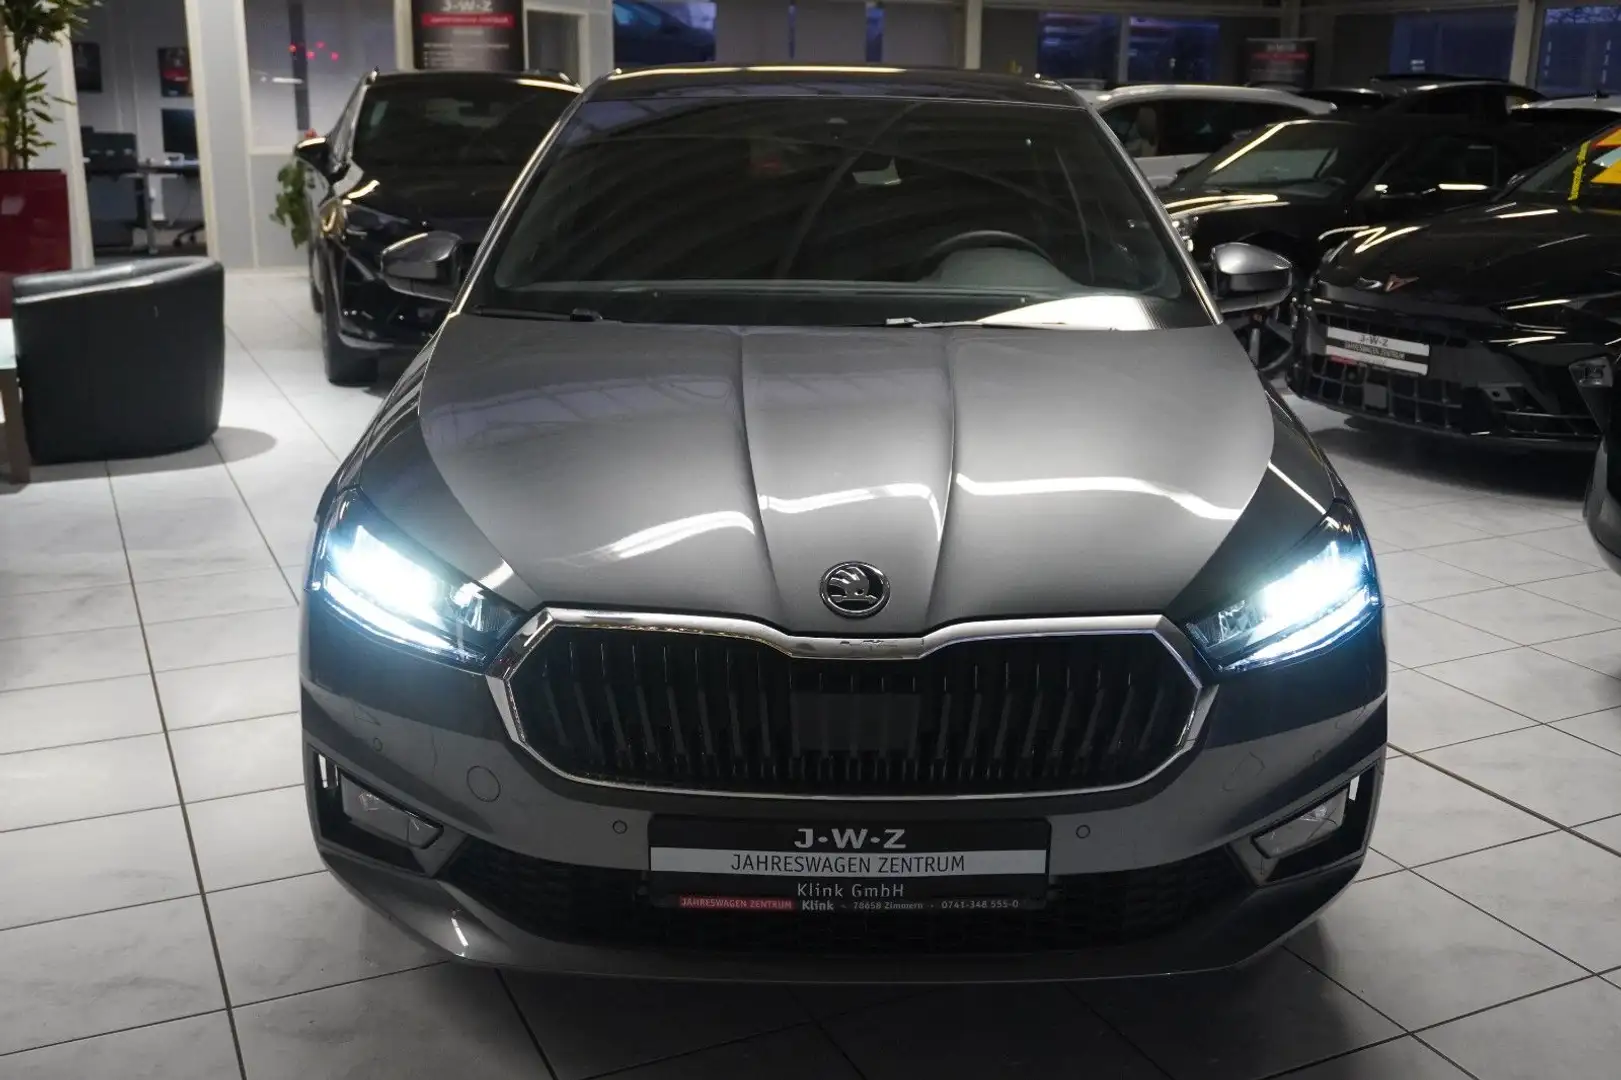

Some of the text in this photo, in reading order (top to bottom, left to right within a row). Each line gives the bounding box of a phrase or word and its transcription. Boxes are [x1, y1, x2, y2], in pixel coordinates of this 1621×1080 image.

[731, 853, 965, 874] JAHRESWAGEN ZENTRUM
[797, 883, 904, 898] Klink GmbH
[681, 897, 748, 908] JAHRESWAGEN
[750, 899, 793, 910] ZENTRUM
[802, 899, 835, 911] Klink
